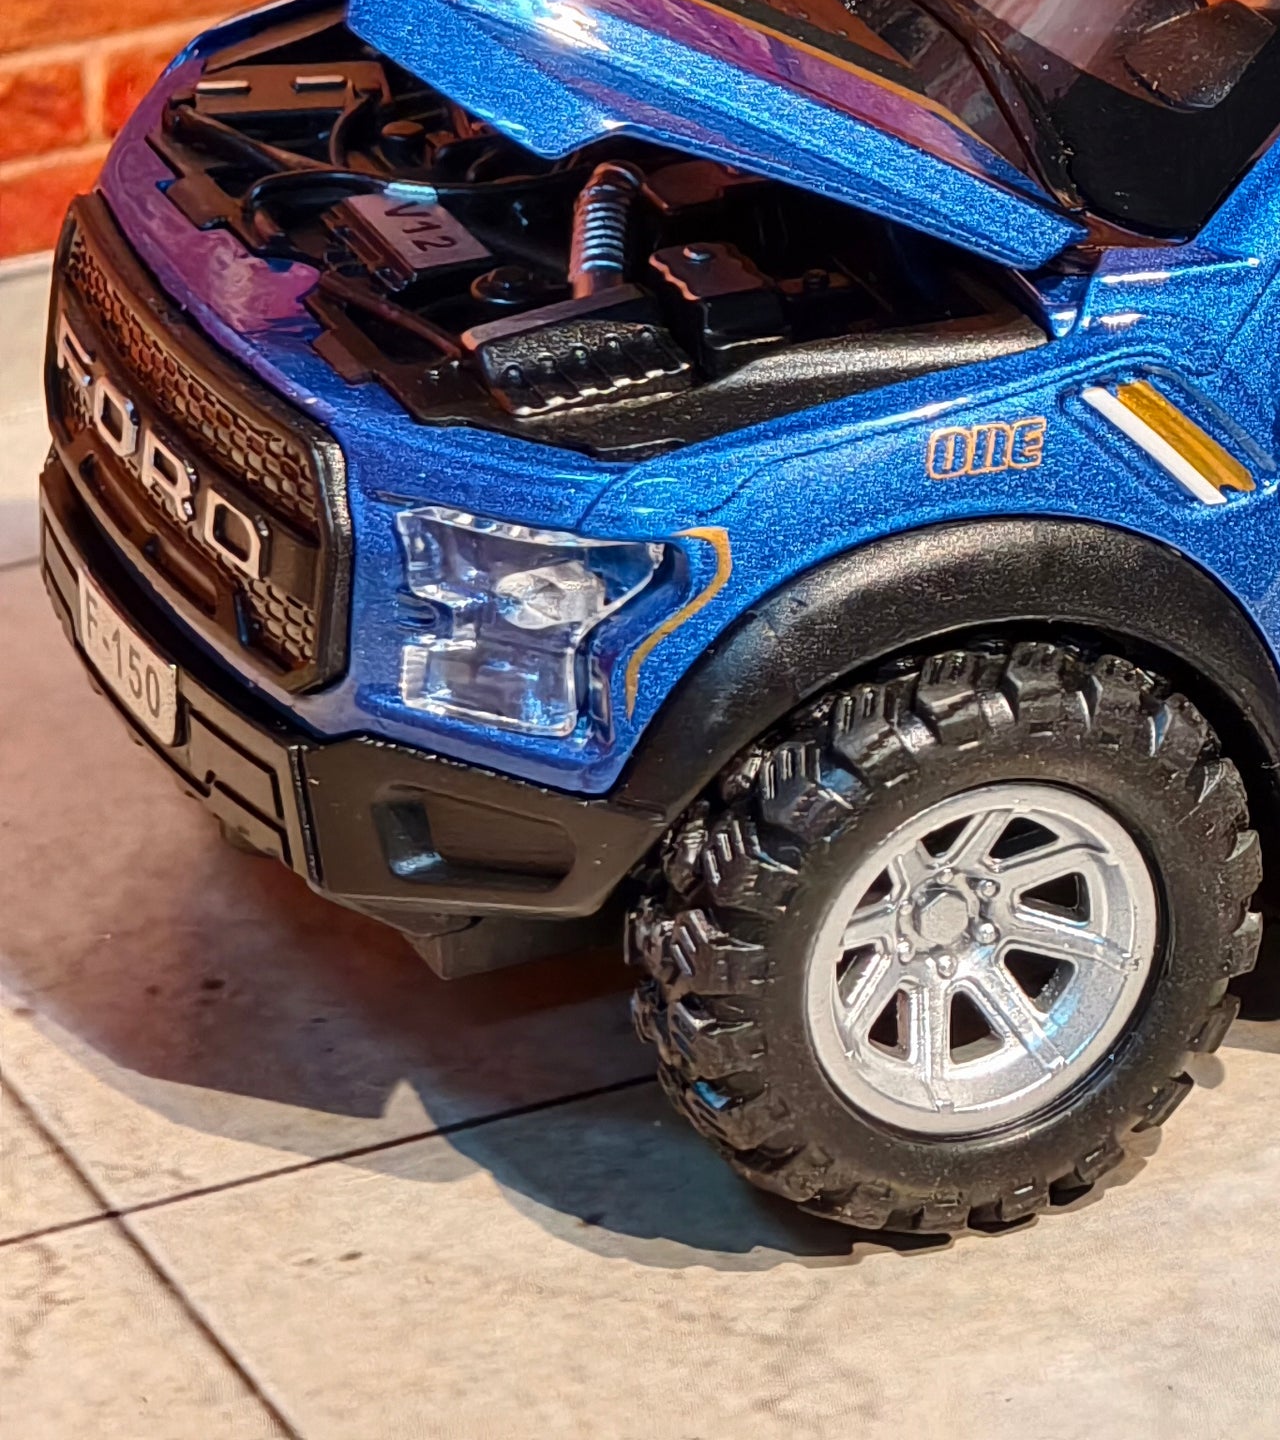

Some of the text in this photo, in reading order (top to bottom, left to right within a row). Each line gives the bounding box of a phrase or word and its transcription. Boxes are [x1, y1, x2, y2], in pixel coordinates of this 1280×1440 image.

[384, 201, 457, 252] V12
[57, 310, 266, 580] FORD
[85, 587, 160, 719] F-150
